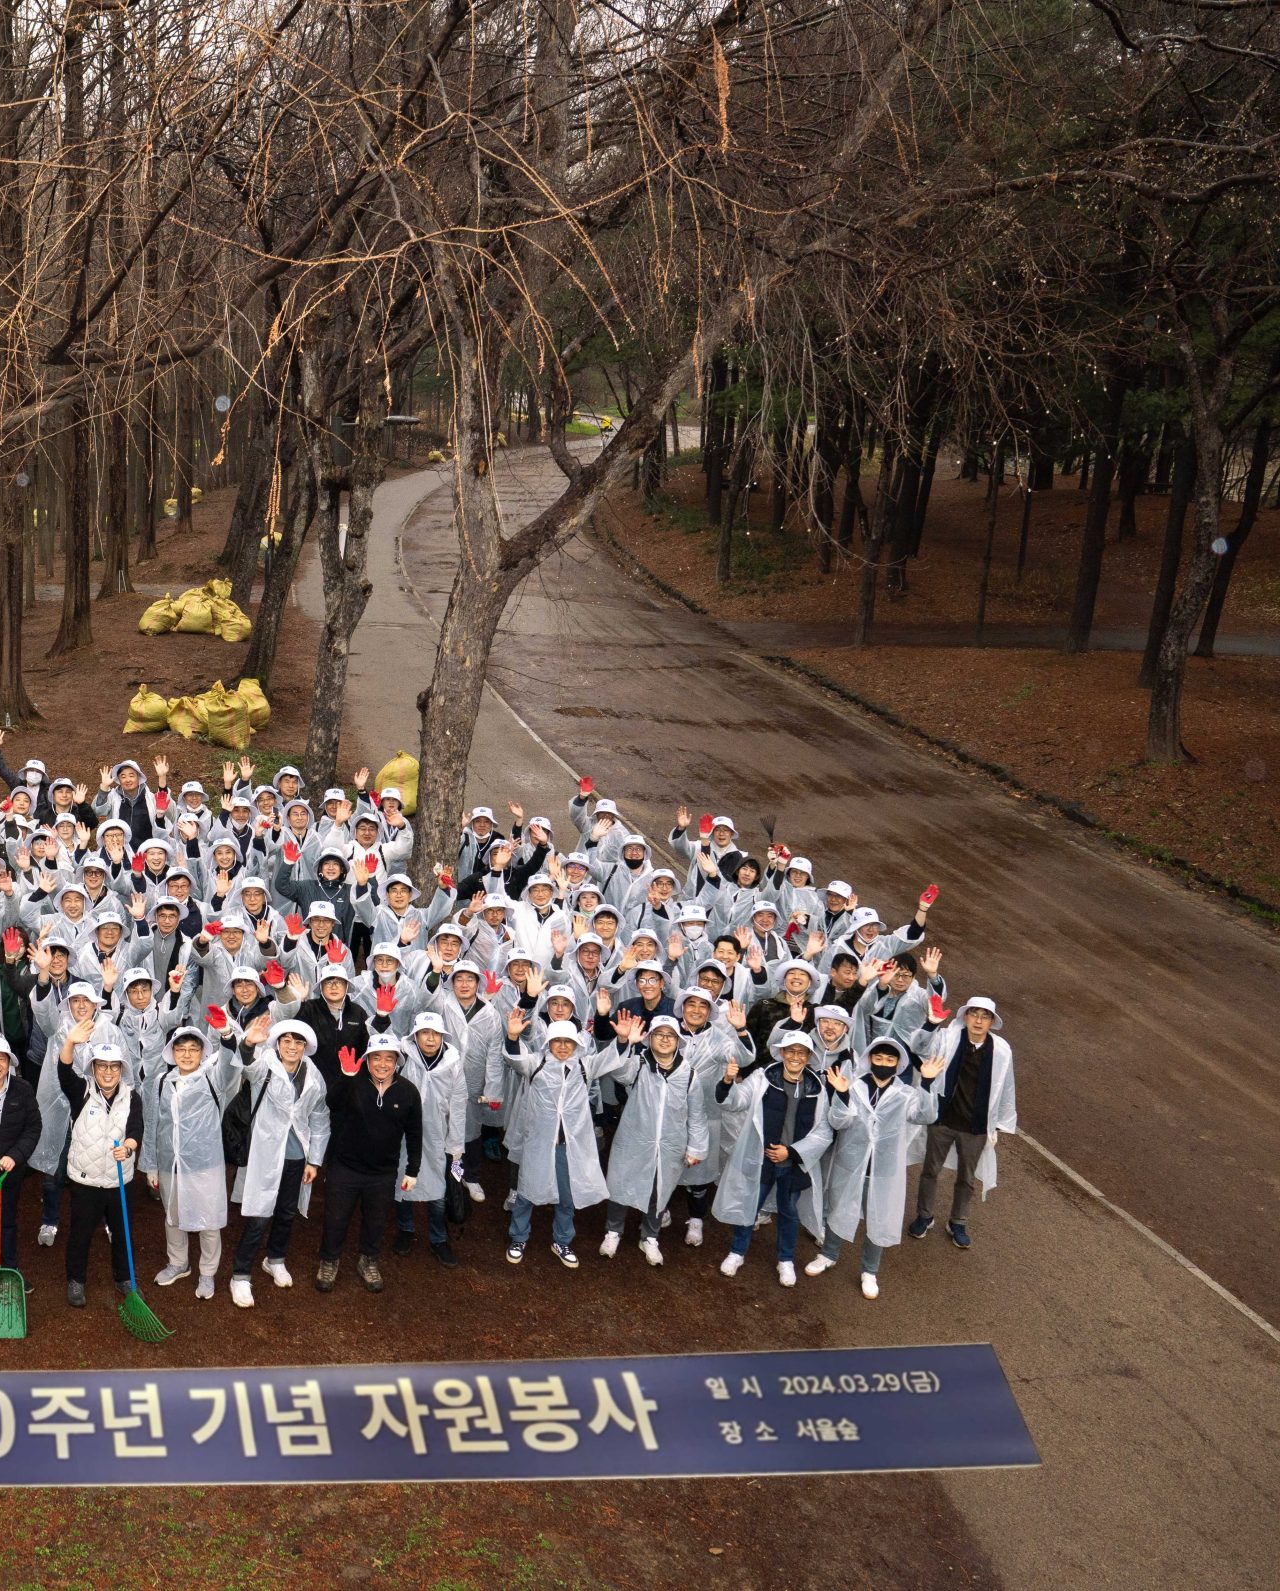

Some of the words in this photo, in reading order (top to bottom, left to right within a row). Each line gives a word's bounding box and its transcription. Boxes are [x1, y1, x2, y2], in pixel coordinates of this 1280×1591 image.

[778, 1370, 940, 1395] 2024.03.29(금)
[188, 1378, 332, 1457] 기념
[352, 1369, 659, 1455] 자원봉사
[797, 1417, 860, 1442] 서울숲
